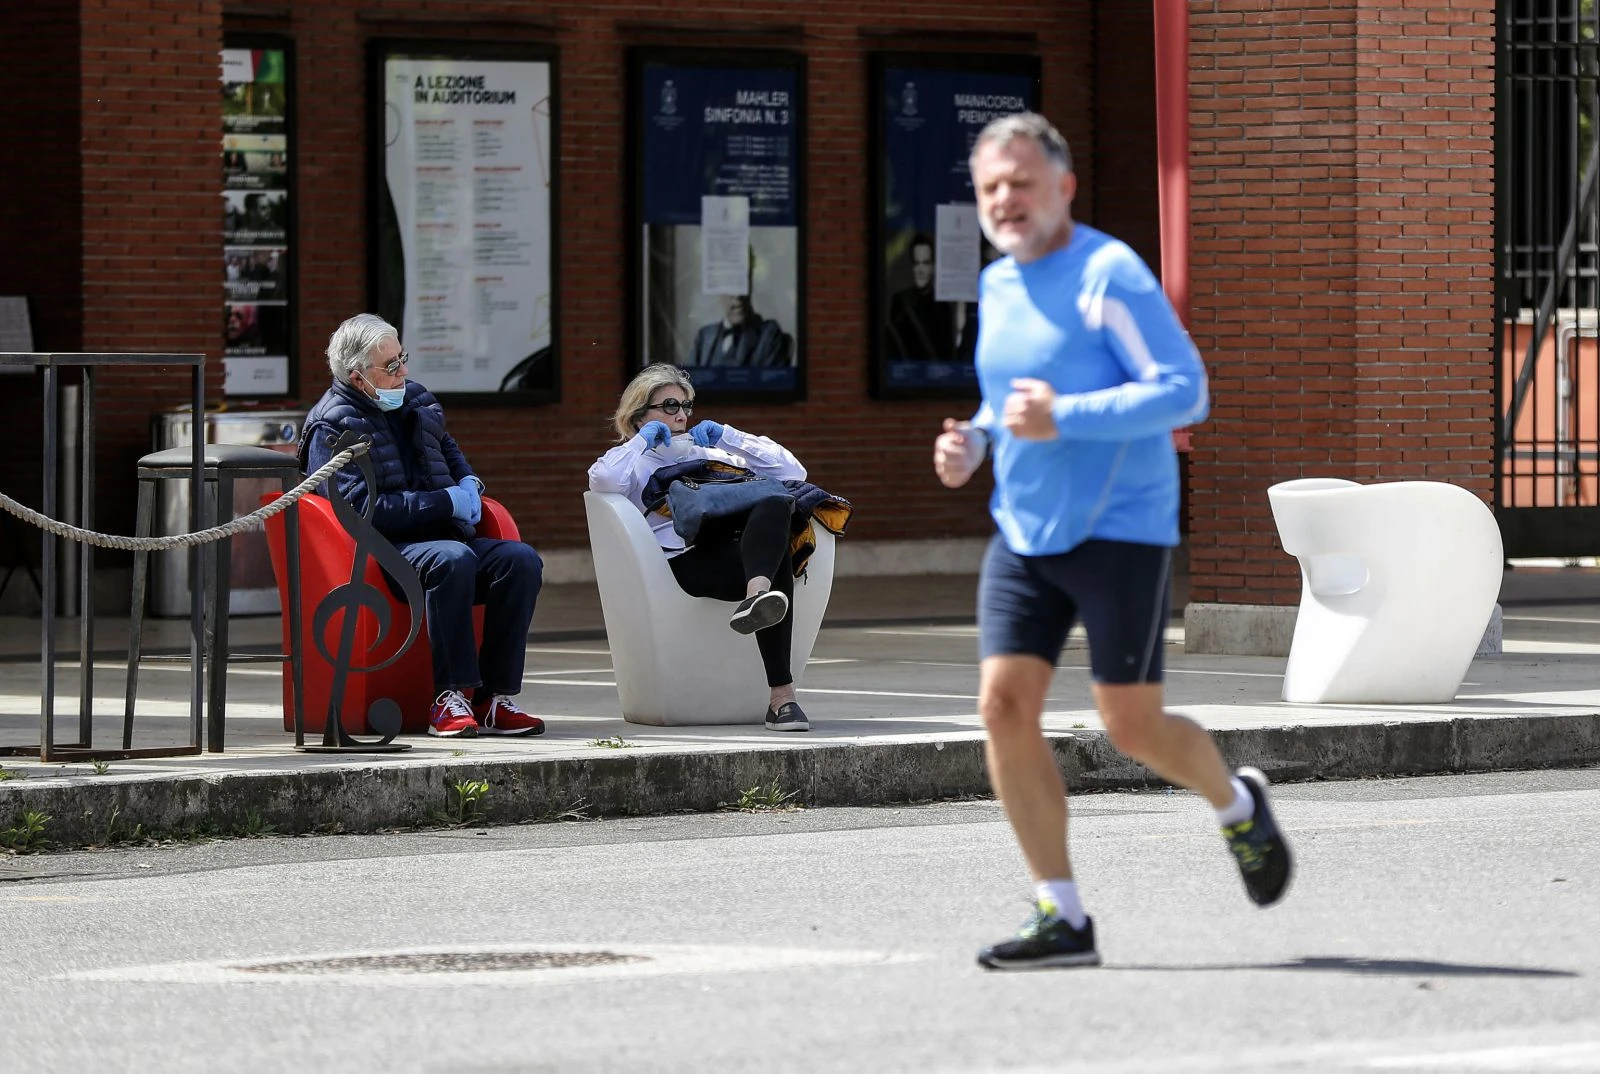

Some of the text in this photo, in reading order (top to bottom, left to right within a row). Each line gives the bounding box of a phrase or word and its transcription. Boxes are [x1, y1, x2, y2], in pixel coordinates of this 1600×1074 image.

[414, 75, 424, 89] A
[427, 76, 485, 89] LEZIONE
[414, 91, 517, 104] IN AUDITORIUM
[736, 90, 789, 106] MAHLER
[954, 94, 1025, 109] MANACORDA
[704, 107, 762, 123] SINFONIA
[780, 110, 789, 125] 3
